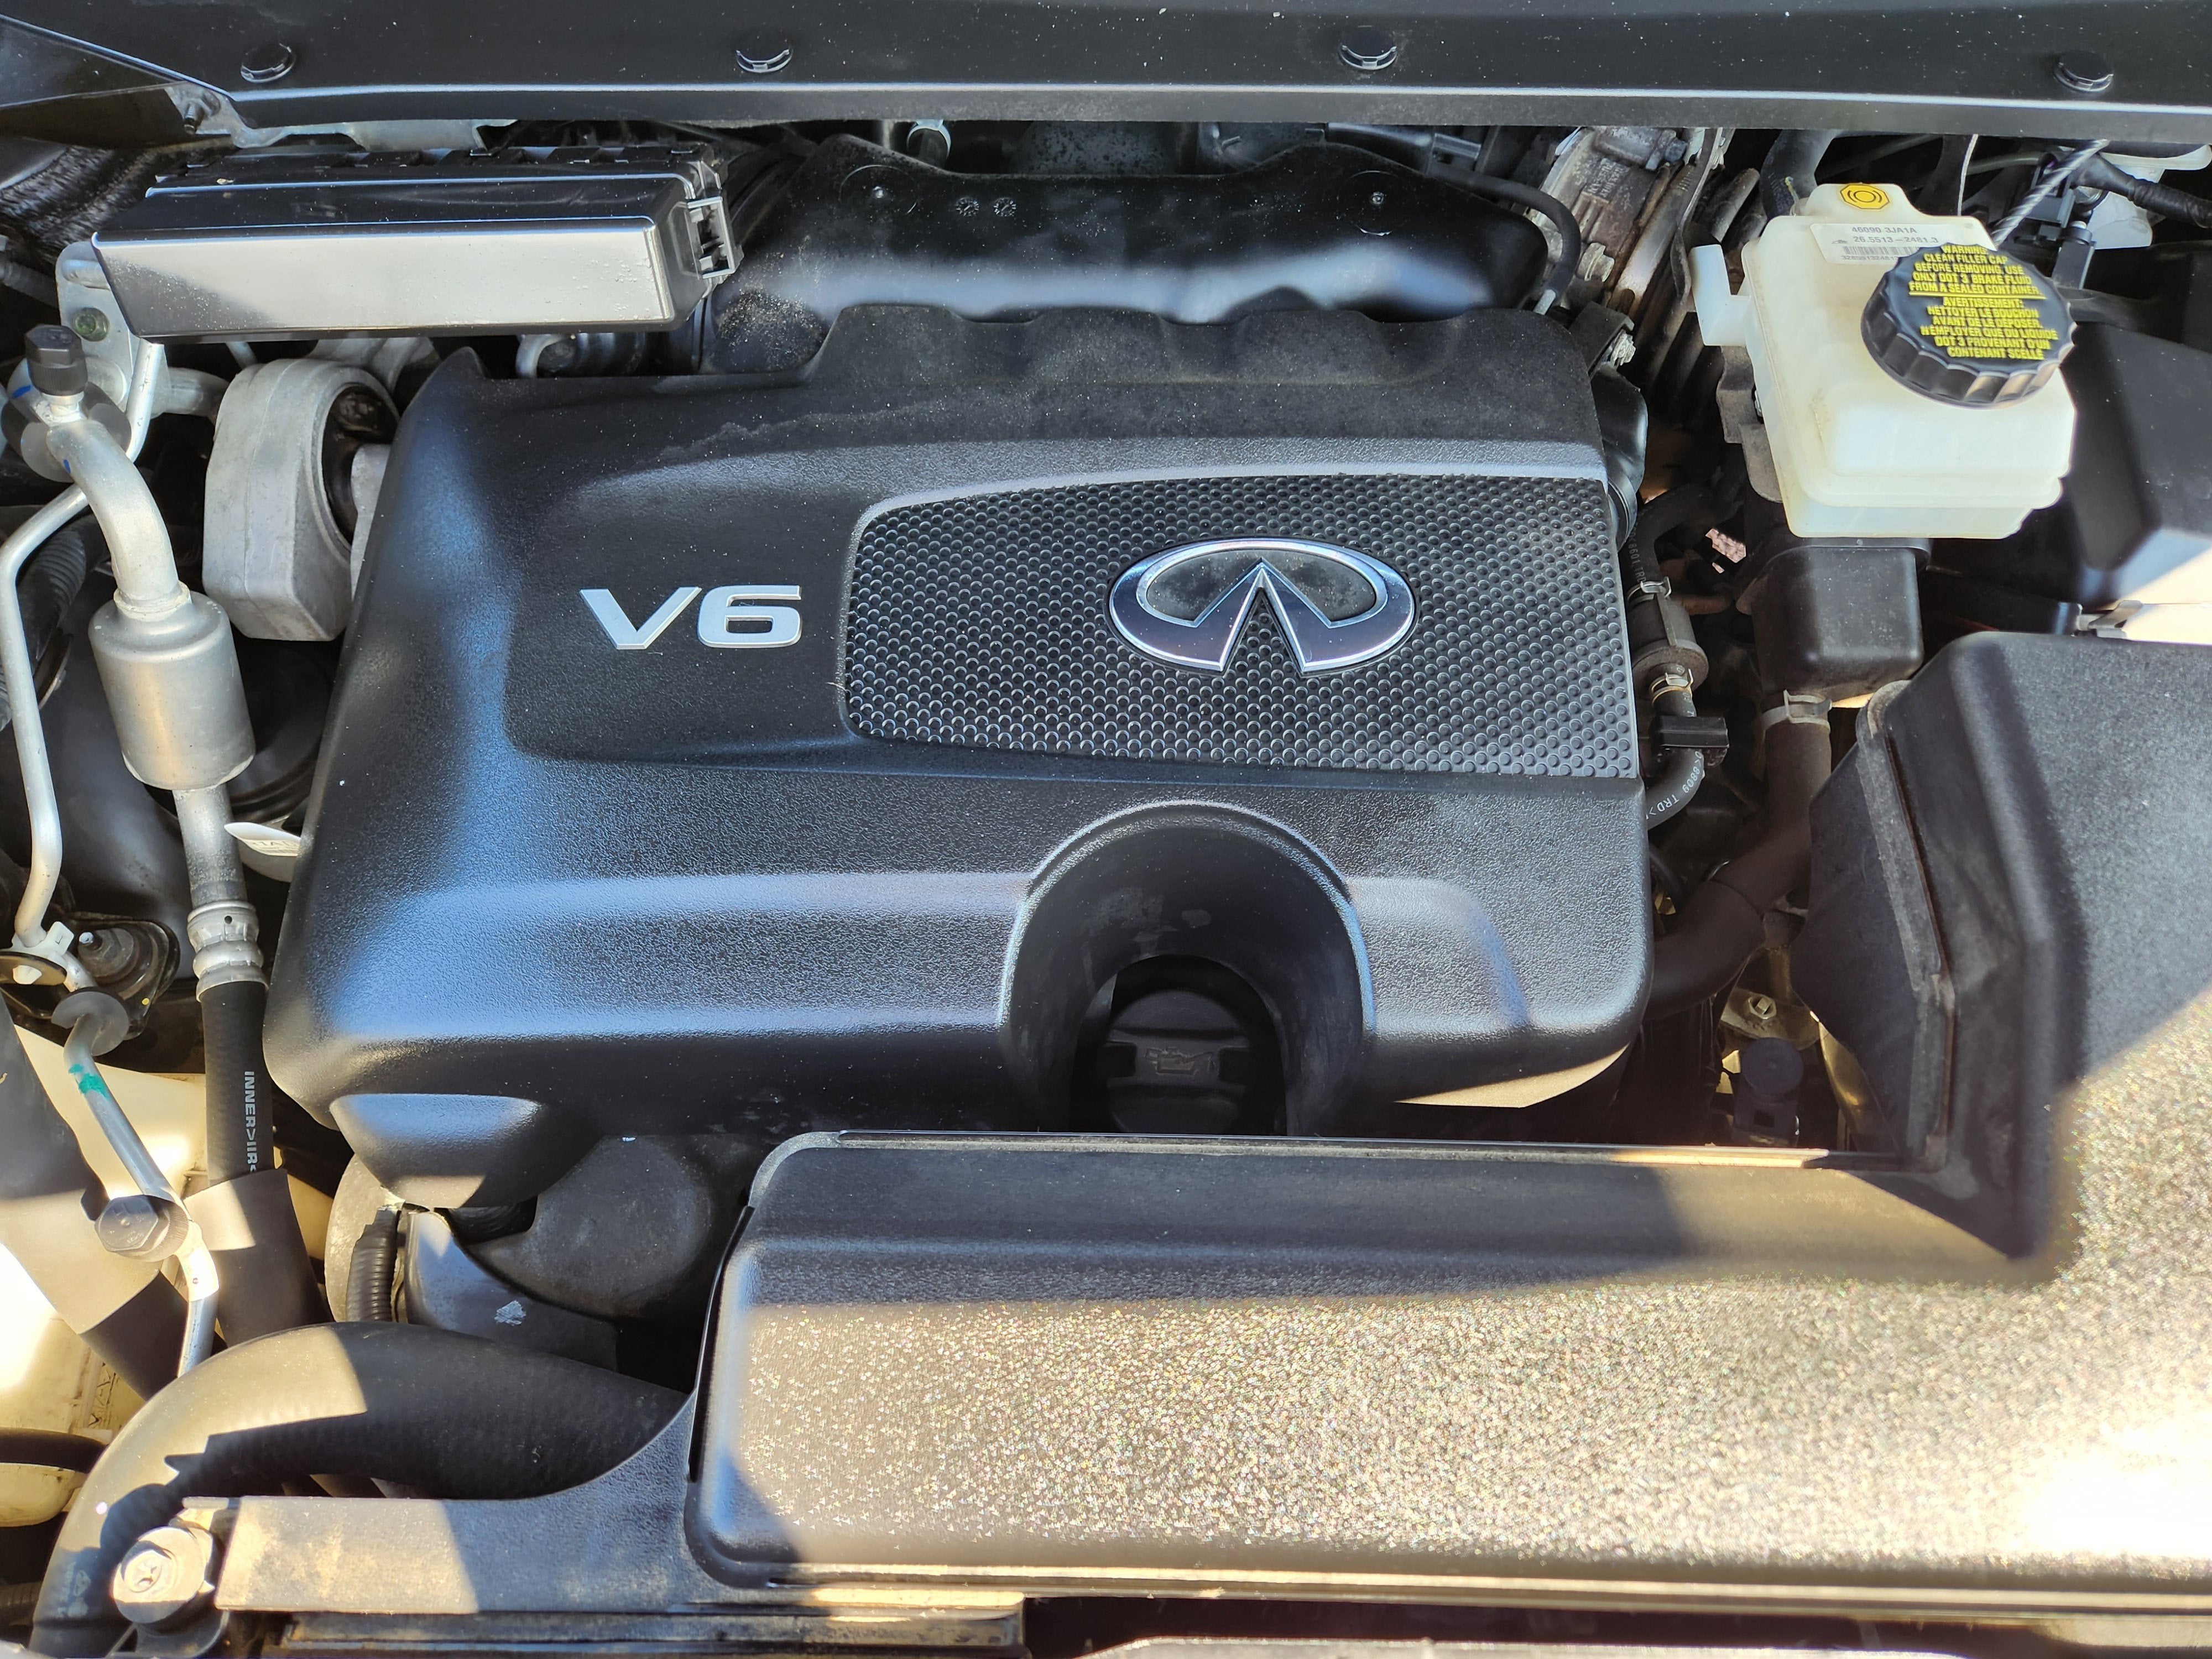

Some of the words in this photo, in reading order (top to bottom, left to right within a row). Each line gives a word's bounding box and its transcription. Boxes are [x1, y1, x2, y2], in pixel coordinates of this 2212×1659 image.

[1924, 253, 1954, 263] CLEAN
[1956, 254, 1988, 264] FILLER
[1989, 256, 2008, 265] CAP
[1914, 262, 1952, 272] BEFORE
[2005, 265, 2025, 275] USE
[1912, 271, 1936, 281] ONLY
[1939, 272, 1959, 283] DOT
[1971, 274, 2005, 284] BRAKE
[2005, 274, 2032, 285] FLUID
[1908, 281, 1938, 291] FROM
[1939, 283, 1948, 293] A
[1948, 283, 1984, 294] SEALED
[1943, 296, 2025, 308] AVERTISSEMENT:
[1927, 306, 1978, 317] NETTOYER
[1979, 308, 1992, 318] LE
[1992, 308, 2040, 319] BOUCHON
[1932, 316, 1967, 326] AVANT
[1968, 317, 1981, 327] DE
[1982, 318, 1995, 327] LE
[1983, 327, 2005, 337] QUE
[2004, 328, 2020, 338] DU
[2020, 328, 2059, 340] LIQUIDE
[1934, 336, 1957, 347] DOT
[1958, 336, 1965, 347] 3
[1965, 337, 2026, 348] PROVENANT
[1947, 346, 2007, 358] CONTENANT
[580, 584, 802, 650] V6
